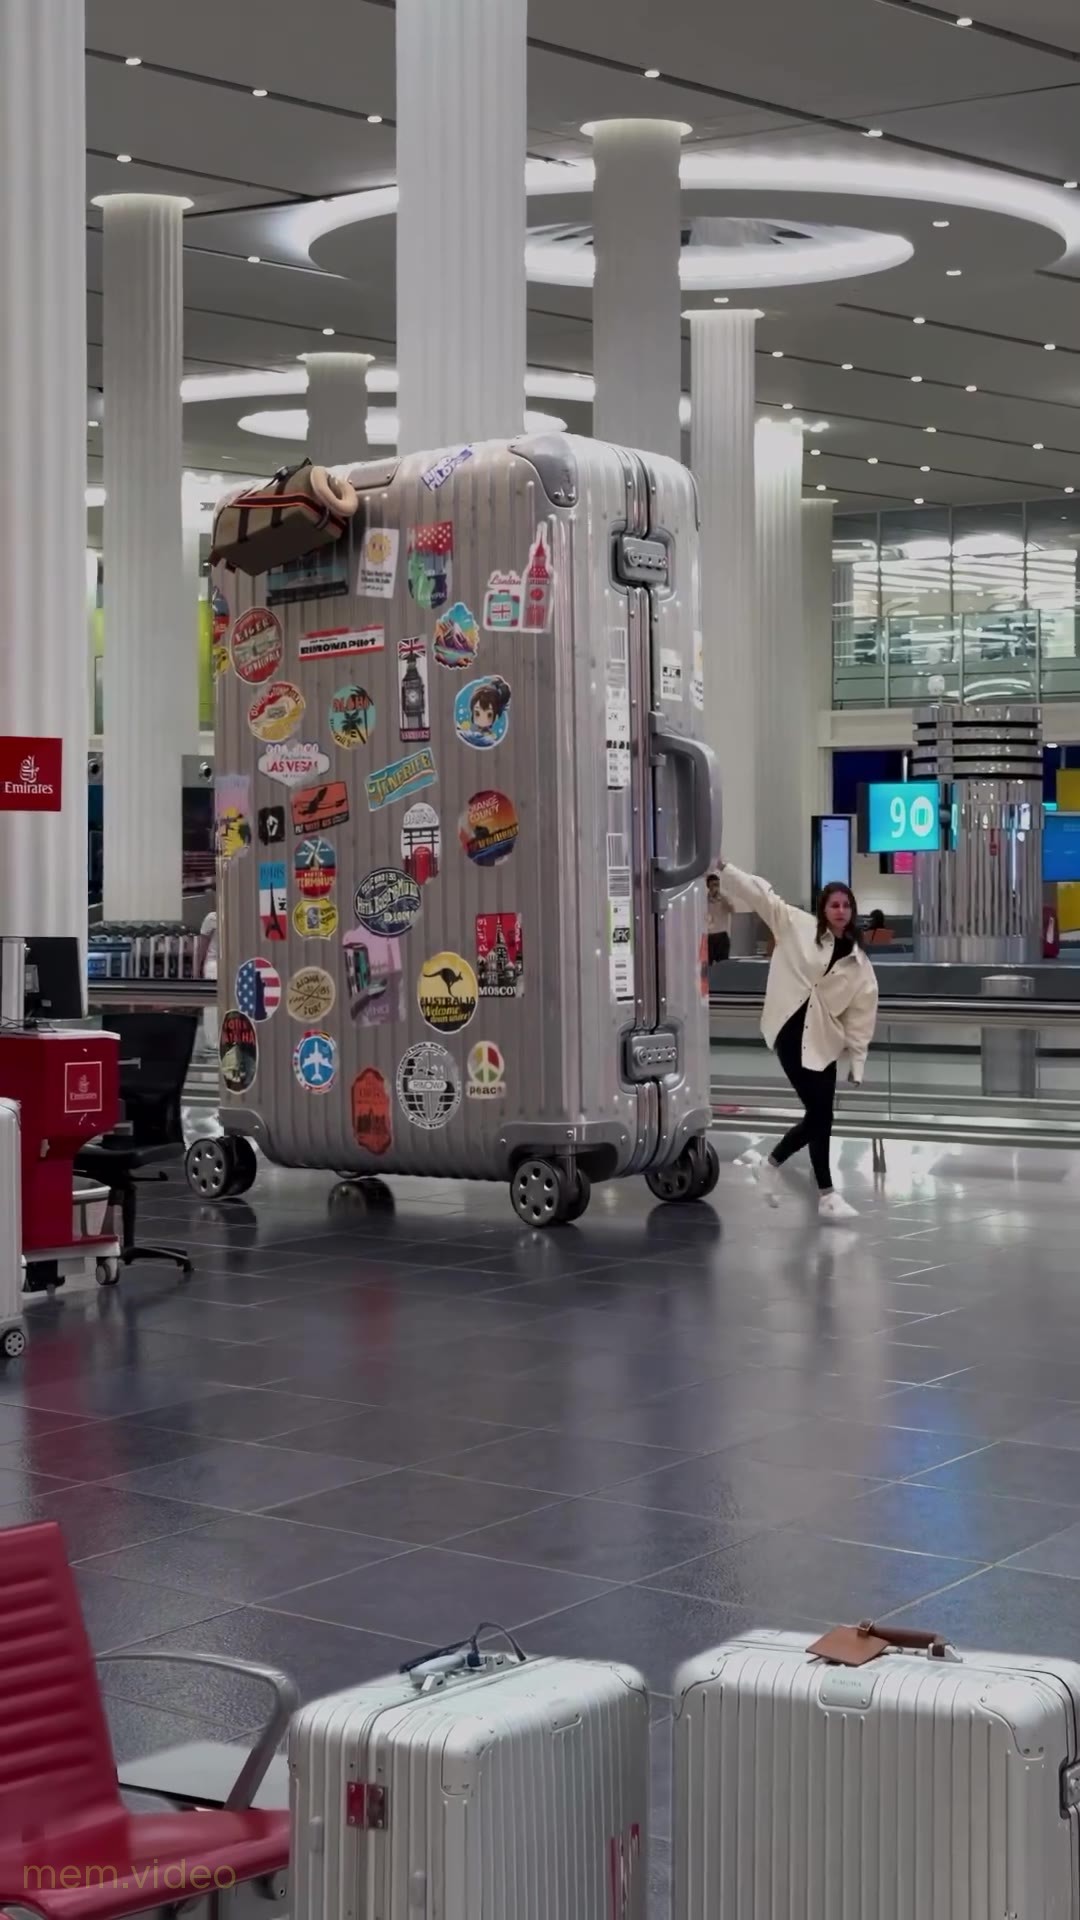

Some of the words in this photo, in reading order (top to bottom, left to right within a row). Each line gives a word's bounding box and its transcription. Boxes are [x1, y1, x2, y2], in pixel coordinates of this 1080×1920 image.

[490, 576, 521, 585] London
[267, 761, 284, 772] LAS
[4, 781, 54, 794] Emirates
[889, 796, 935, 838] 90
[479, 986, 517, 996] MOSCO
[420, 996, 476, 1005] AUSTRALIA
